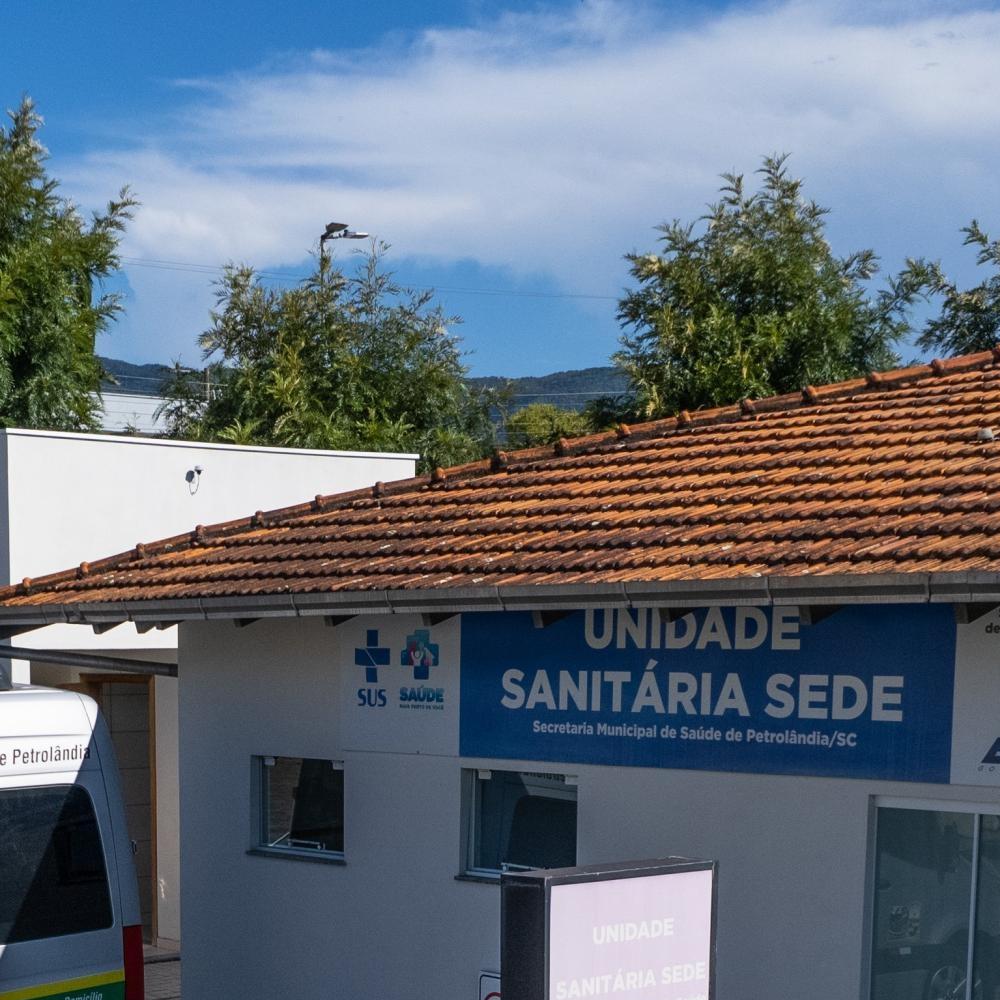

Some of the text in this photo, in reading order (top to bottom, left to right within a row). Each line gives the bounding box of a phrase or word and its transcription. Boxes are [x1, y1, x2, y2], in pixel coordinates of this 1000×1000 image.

[585, 606, 800, 650] UNIDADE
[985, 623, 1000, 634] de
[358, 688, 387, 708] SUS
[501, 659, 904, 722] SANITÁRIA SEDE
[533, 720, 857, 748] Secretaria Municipal de Saúde de Petrolândia/SC
[13, 744, 90, 764] Petrolândia
[592, 918, 674, 945] UNIDADE
[555, 962, 706, 1000] SANITÁRIA SEDE
